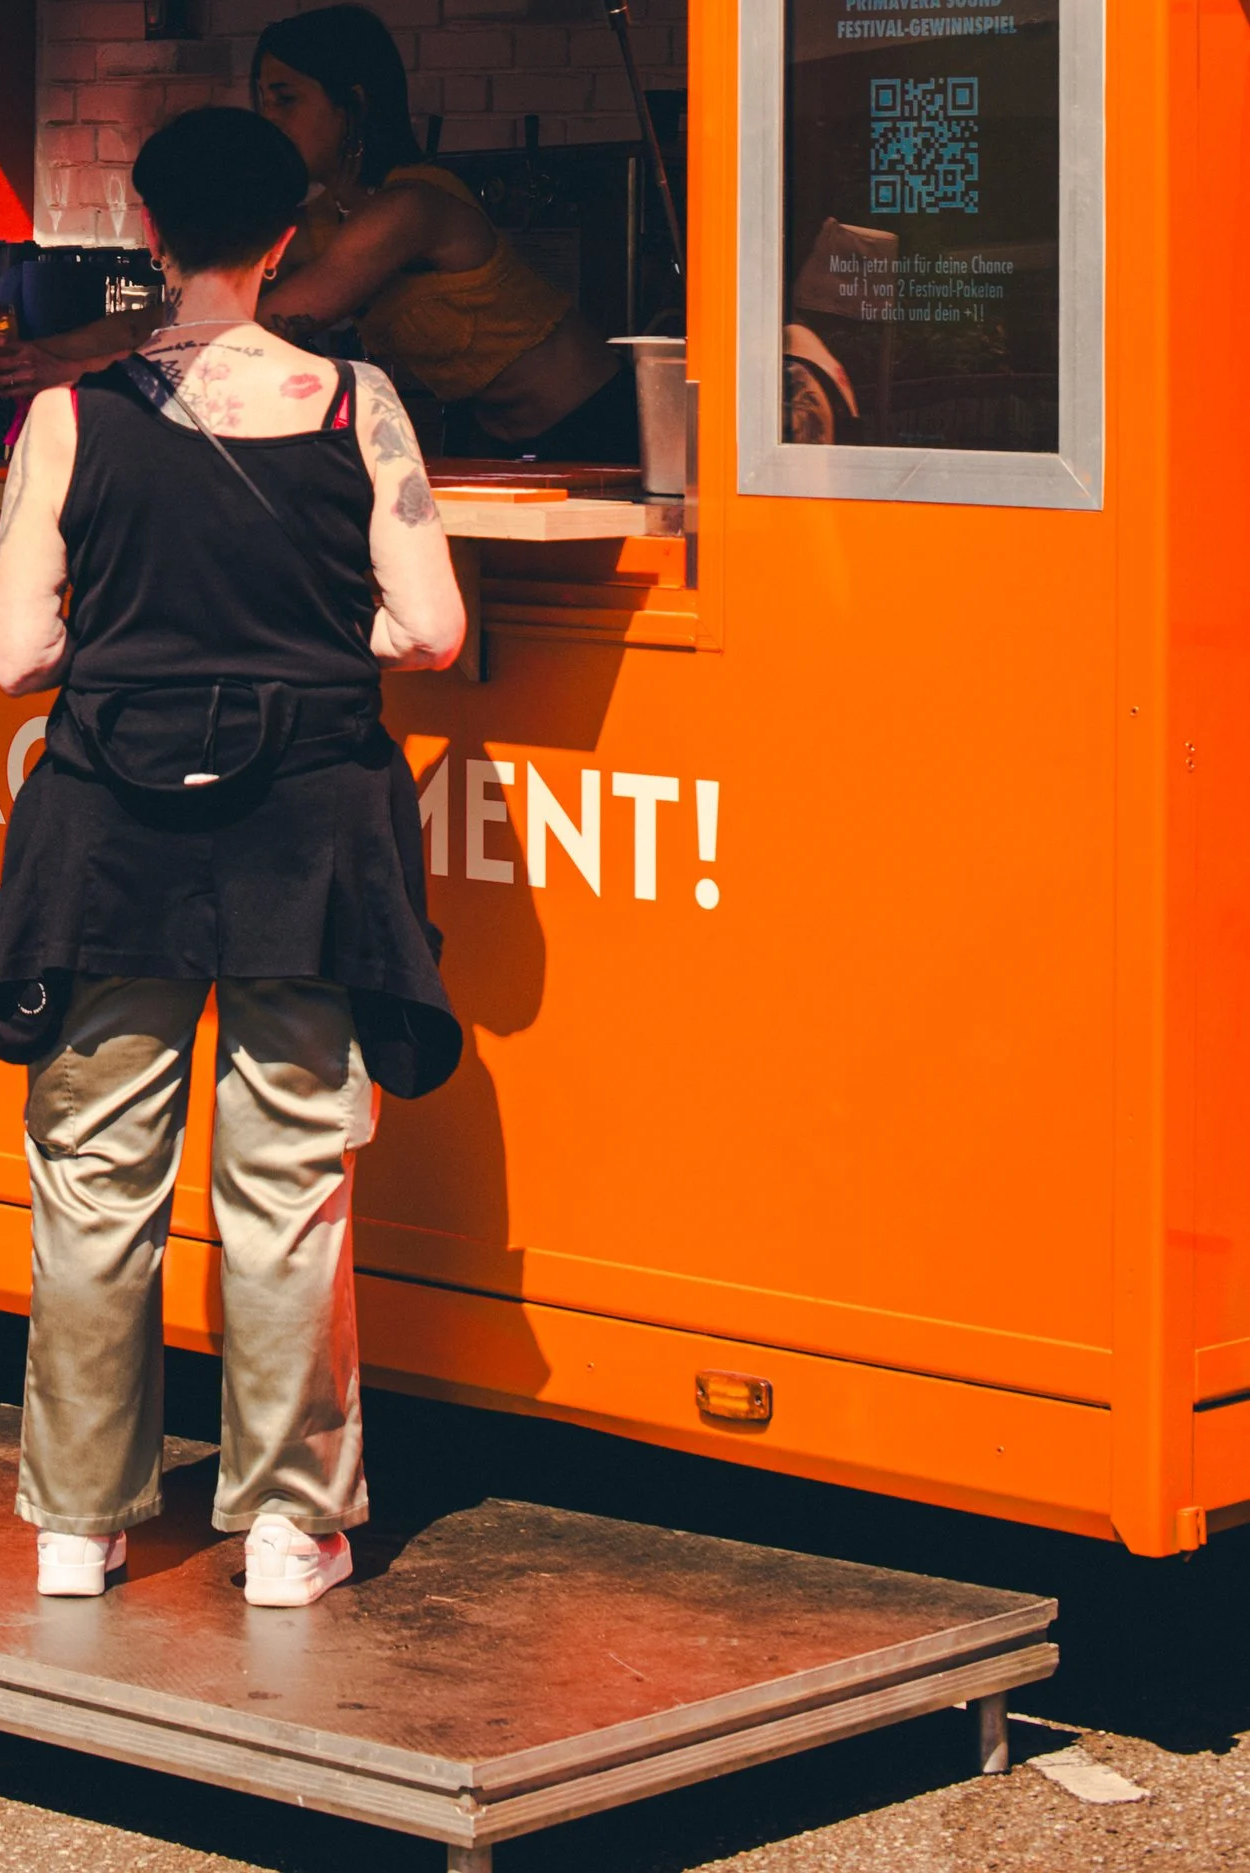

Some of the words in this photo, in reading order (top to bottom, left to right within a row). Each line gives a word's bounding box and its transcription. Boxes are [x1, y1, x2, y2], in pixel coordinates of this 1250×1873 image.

[837, 15, 1017, 39] FESTIVAL-GEWINNSPIEL
[829, 254, 860, 274] Mach
[863, 255, 888, 277] jetzt
[892, 255, 911, 274] mit
[914, 254, 931, 274] für
[935, 254, 968, 274] deine
[971, 255, 1014, 274] Chance
[839, 277, 859, 297] auf
[873, 284, 894, 297] von
[898, 279, 905, 297] 2
[909, 278, 1004, 298] Festival-Paketen
[861, 301, 878, 321] für
[882, 301, 904, 321] dich
[909, 302, 931, 321] und
[935, 302, 960, 322] dein
[964, 303, 985, 322] +1!
